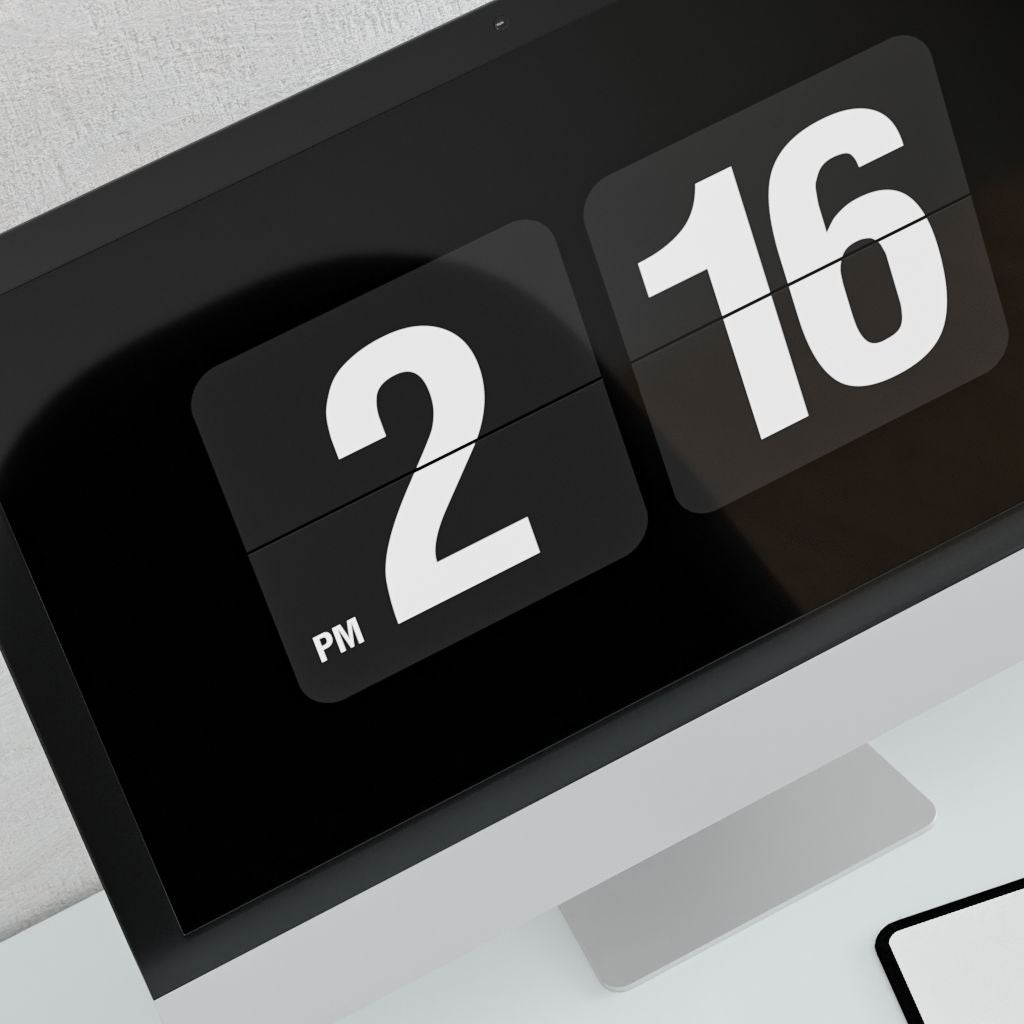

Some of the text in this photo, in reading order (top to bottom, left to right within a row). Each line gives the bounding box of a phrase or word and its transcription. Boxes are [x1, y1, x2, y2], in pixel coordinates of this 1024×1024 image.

[326, 108, 947, 625] 2 16
[312, 617, 364, 663] PM
